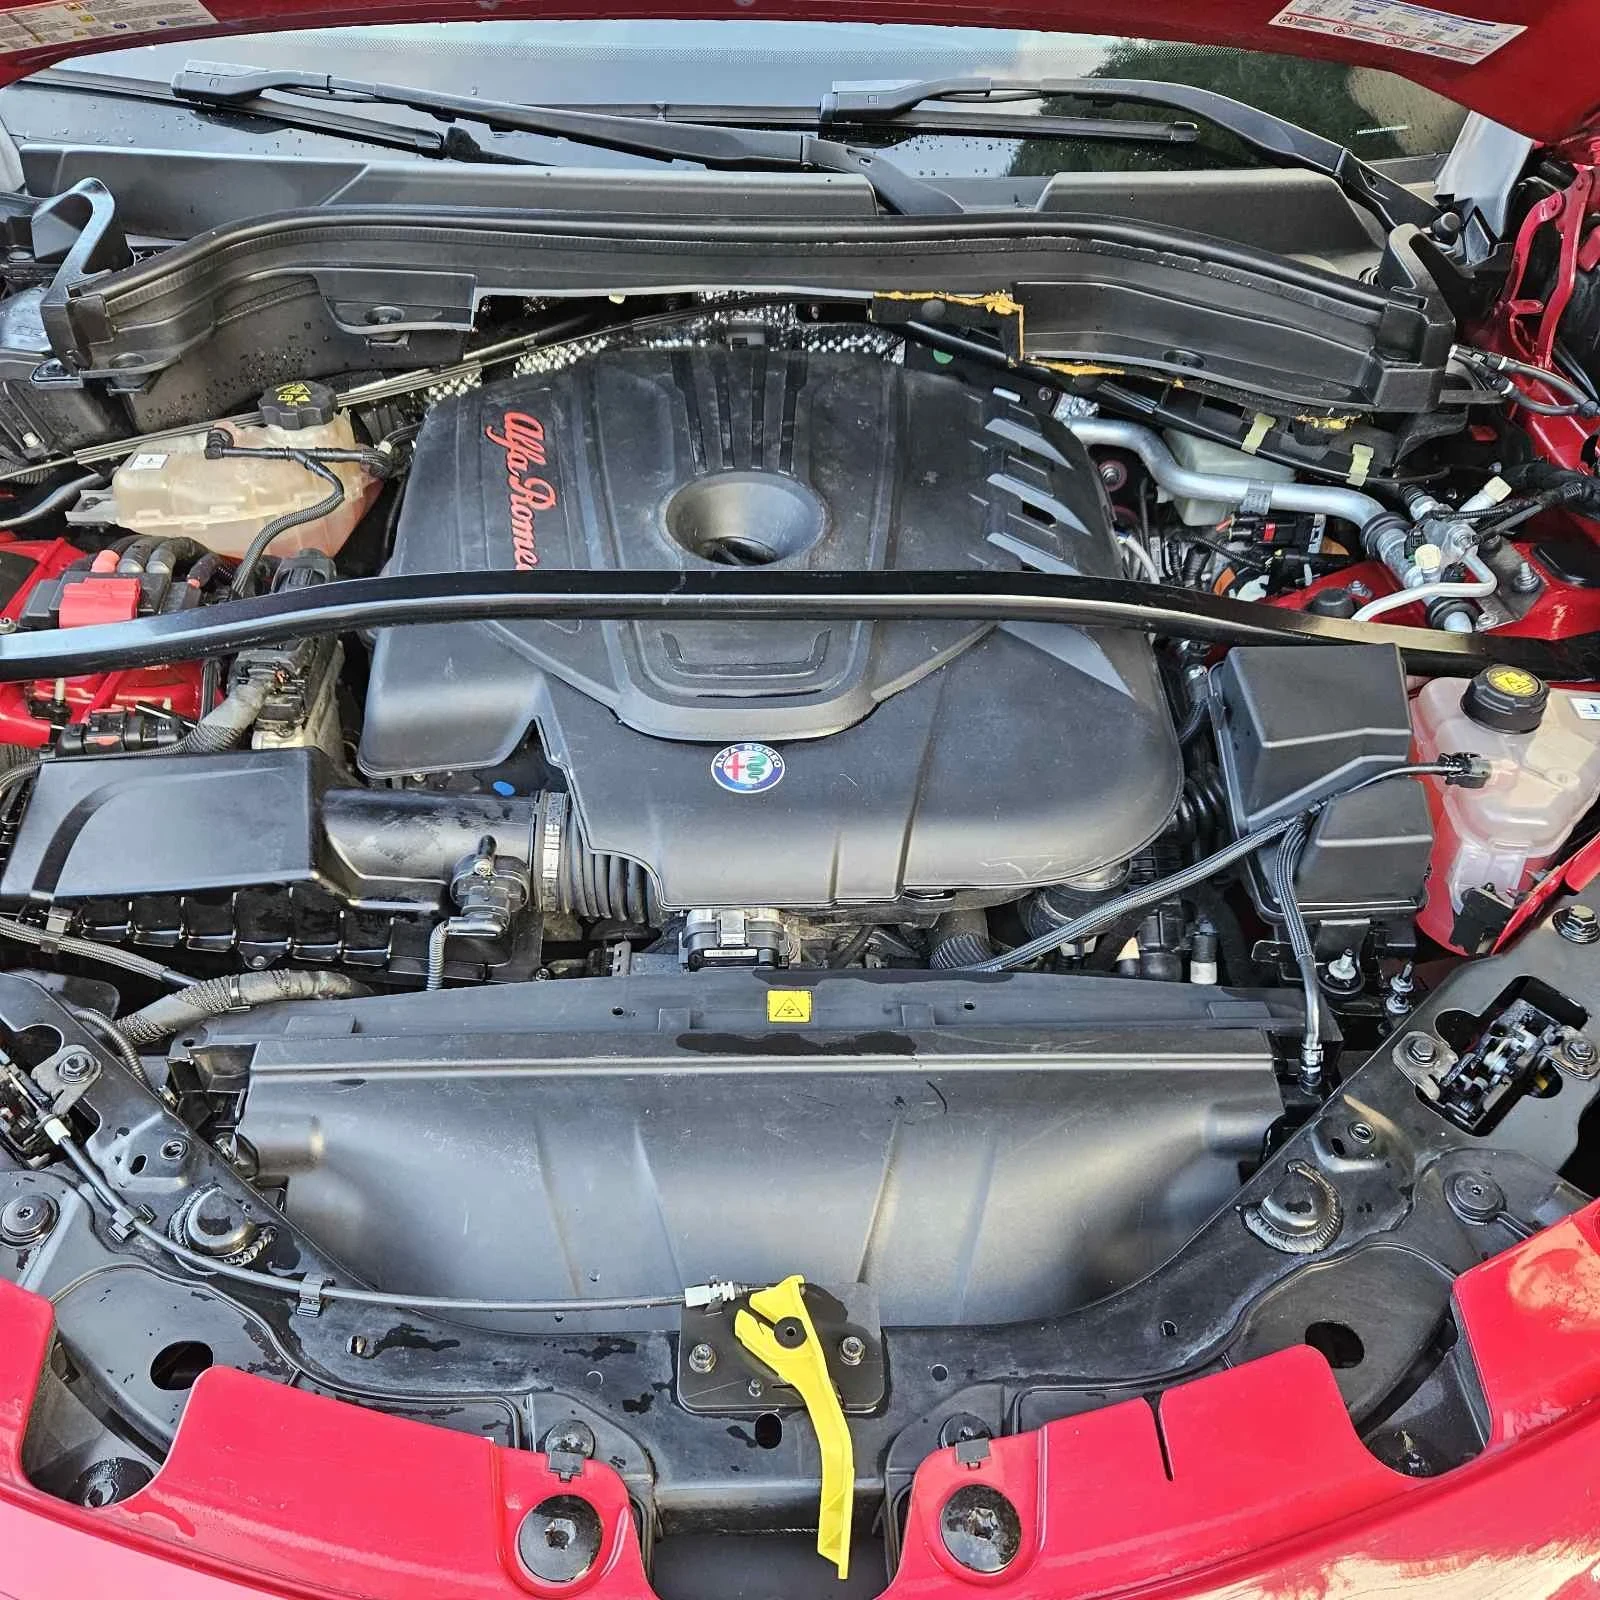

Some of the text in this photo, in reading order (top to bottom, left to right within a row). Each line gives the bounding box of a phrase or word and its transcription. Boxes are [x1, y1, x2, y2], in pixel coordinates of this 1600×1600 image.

[485, 410, 547, 477] Alfa
[715, 744, 782, 768] ALFA ROMEO
